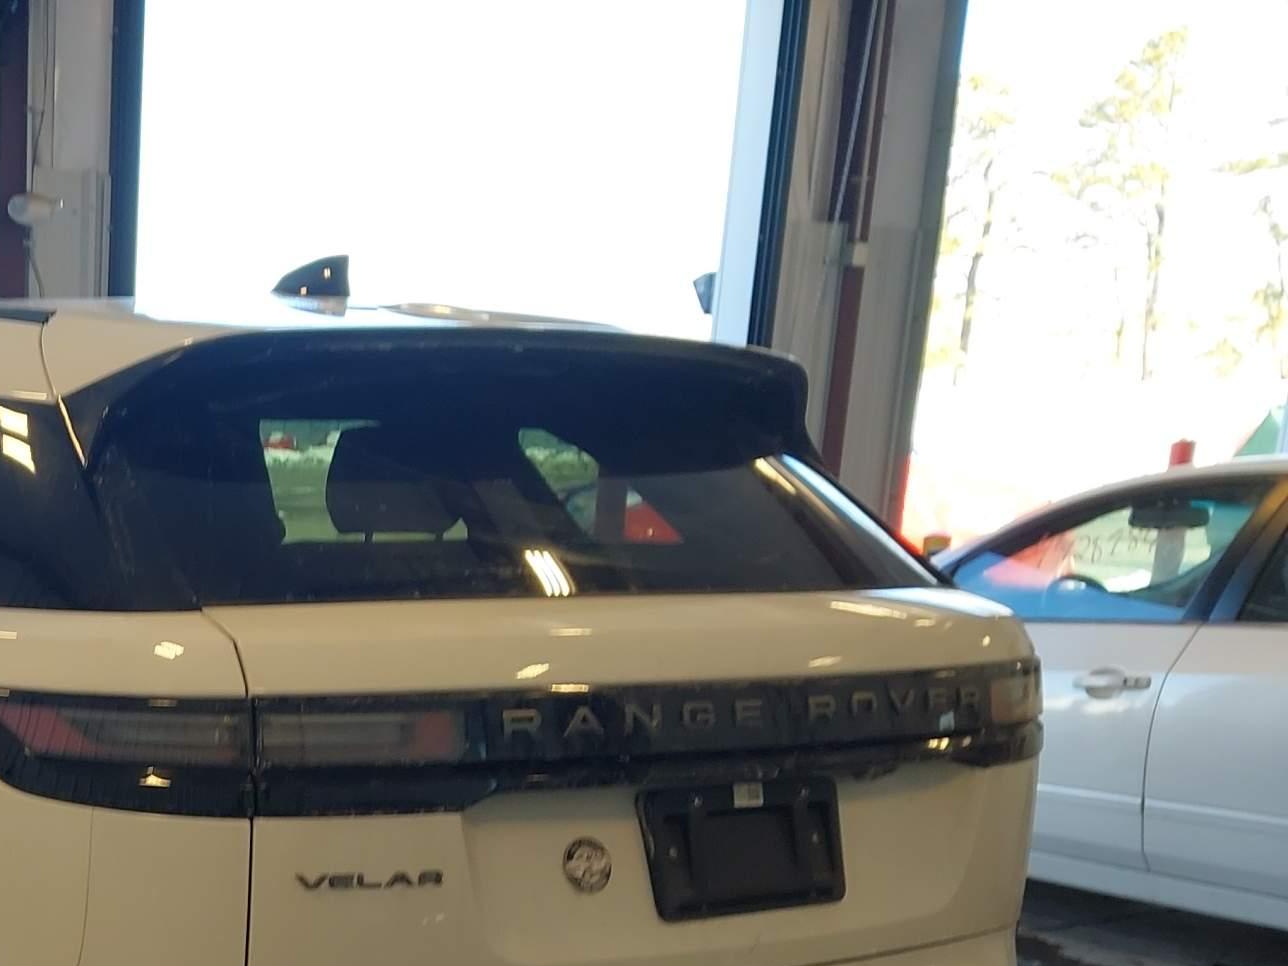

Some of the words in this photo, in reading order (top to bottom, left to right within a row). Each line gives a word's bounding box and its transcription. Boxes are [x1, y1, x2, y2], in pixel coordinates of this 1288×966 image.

[502, 698, 763, 743] RANGE
[807, 686, 982, 722] ROVER
[295, 870, 443, 891] VELAR
